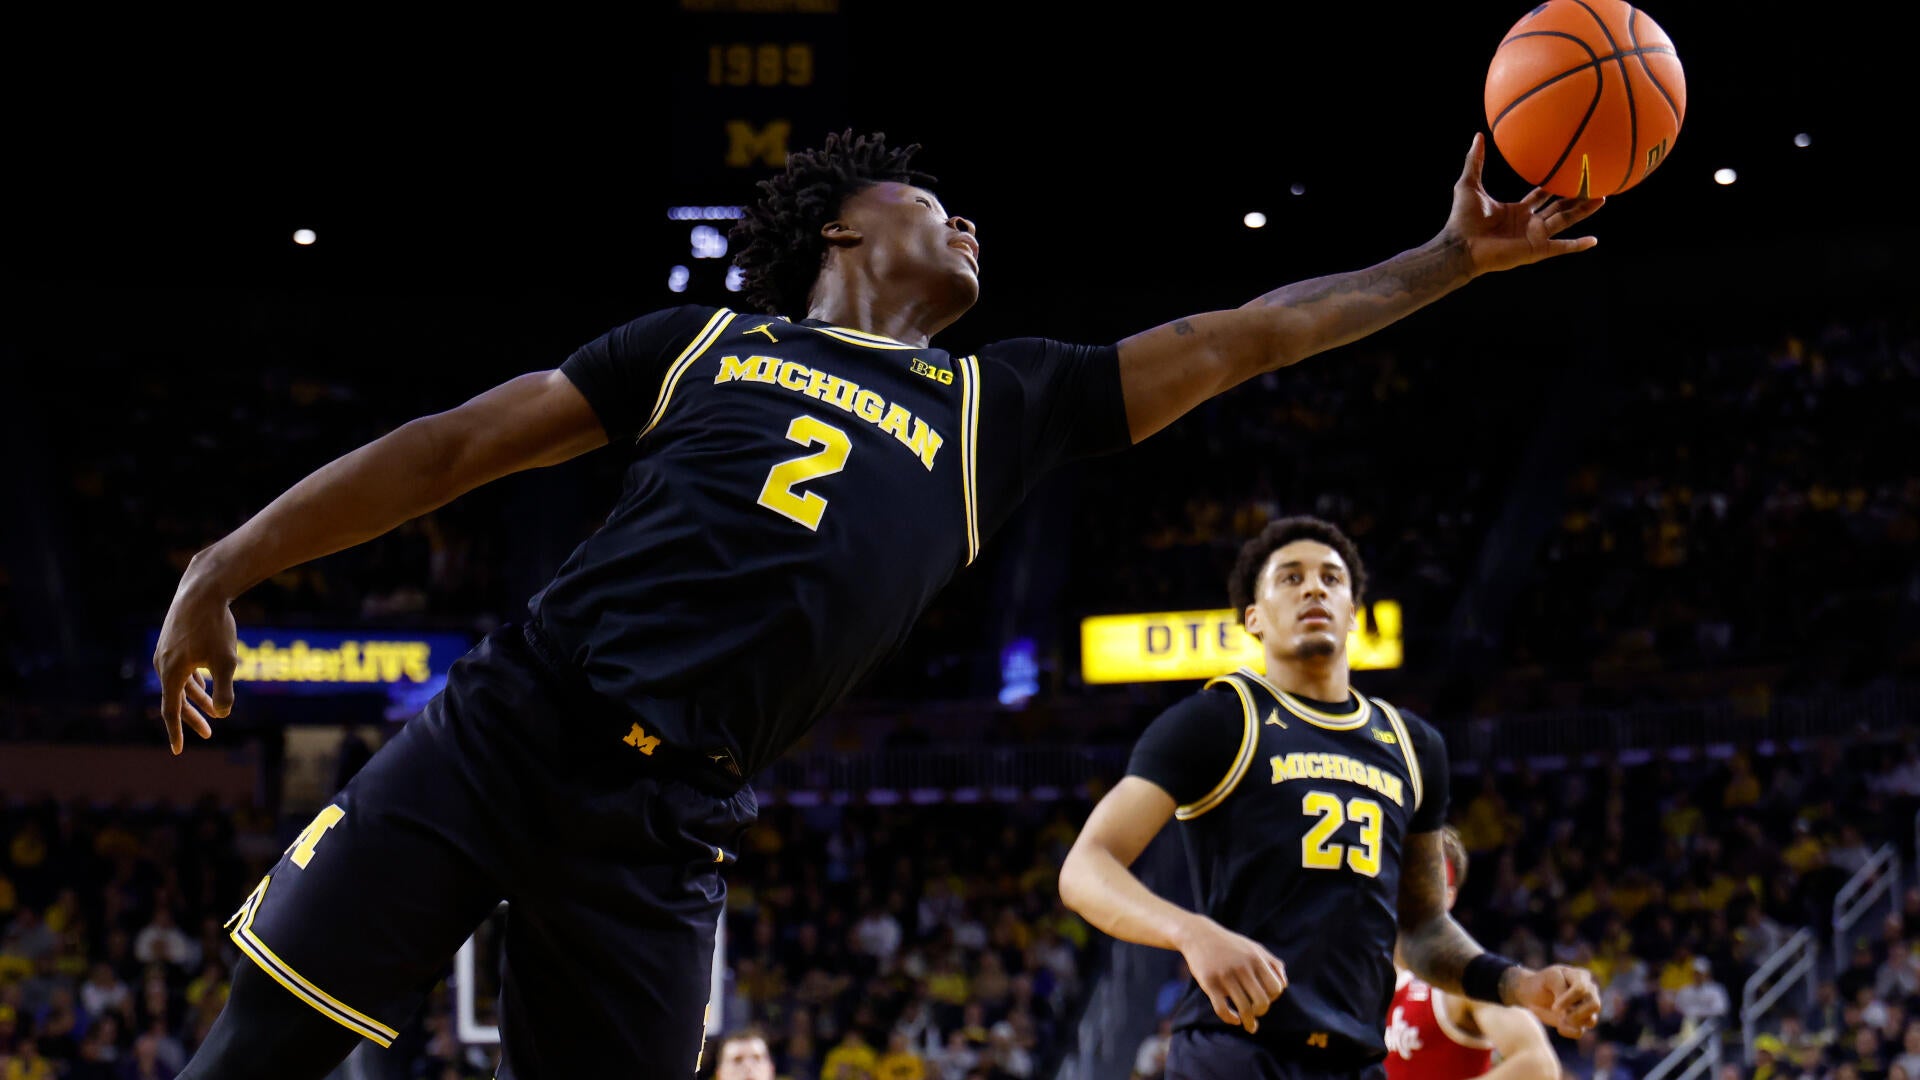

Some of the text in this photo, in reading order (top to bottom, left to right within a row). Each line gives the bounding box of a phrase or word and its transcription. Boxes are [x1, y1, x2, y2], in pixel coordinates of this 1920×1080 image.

[707, 42, 814, 88] 1989
[714, 355, 944, 472] MICHIGAN
[757, 415, 852, 532] 2
[1269, 752, 1405, 808] MICHIGAN
[1302, 789, 1384, 879] 23
